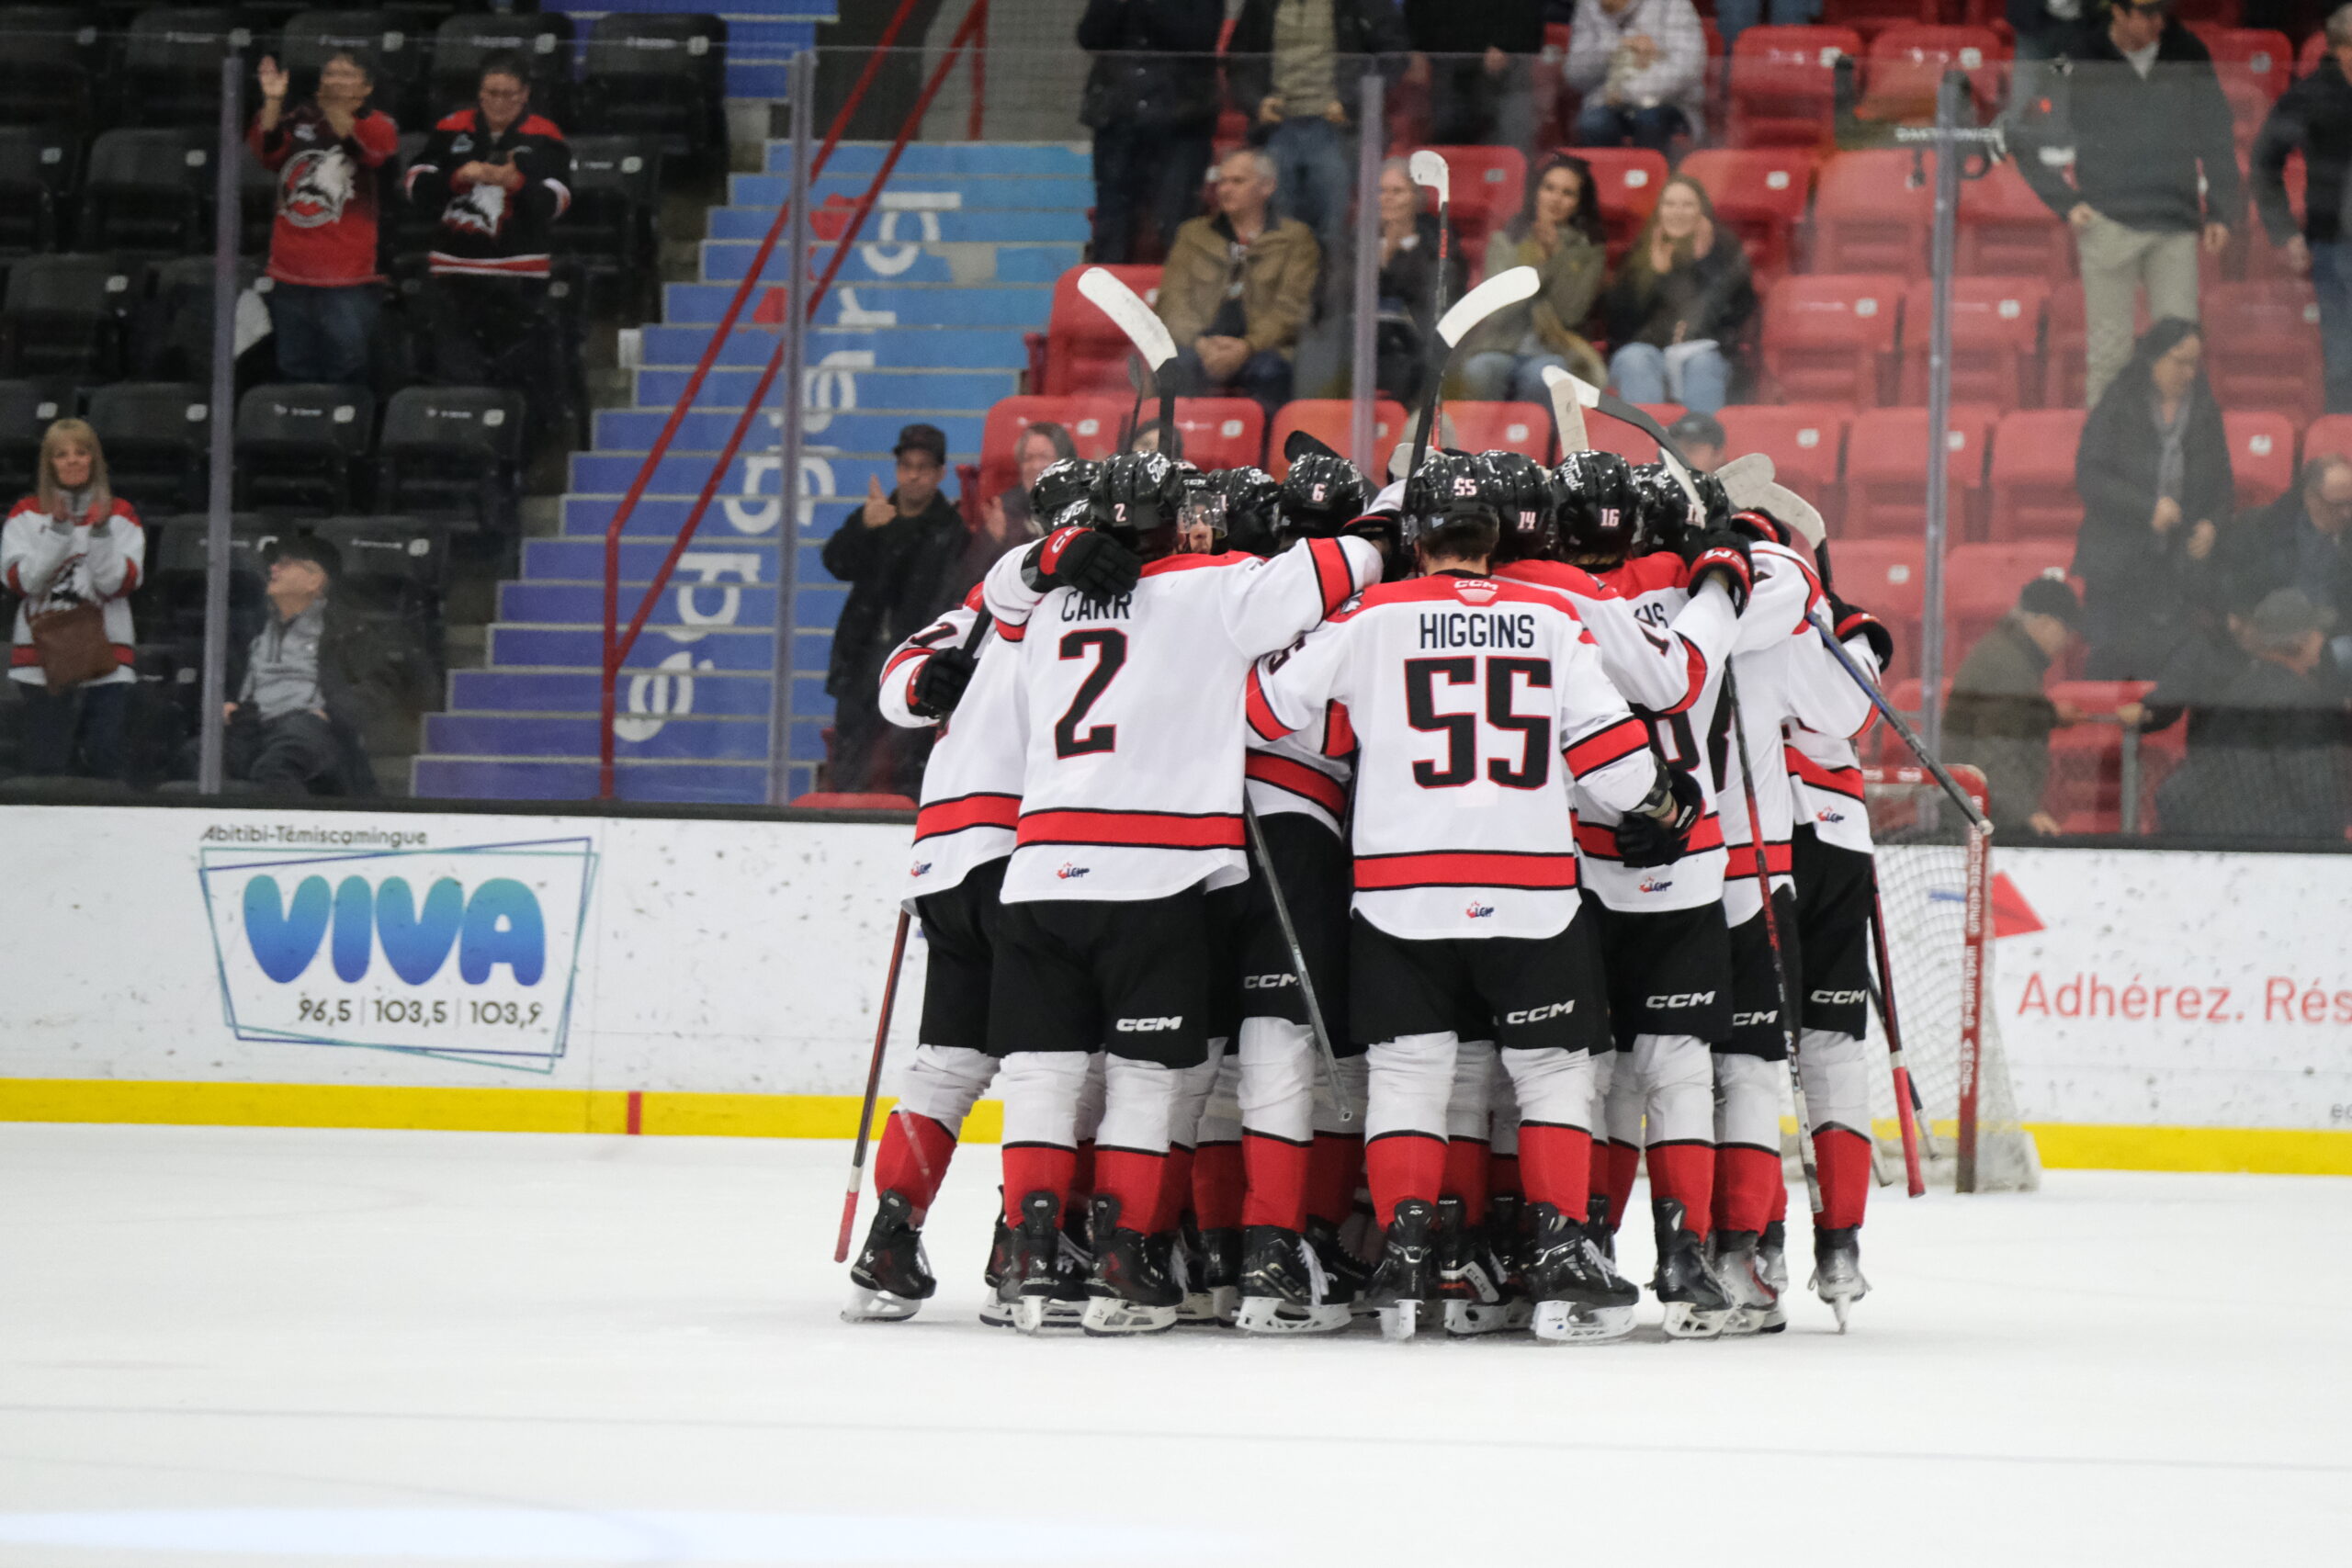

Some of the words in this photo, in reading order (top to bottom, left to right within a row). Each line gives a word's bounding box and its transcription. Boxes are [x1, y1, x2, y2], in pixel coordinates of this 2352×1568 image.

[1312, 483, 1326, 502] 6
[1453, 477, 1477, 497] 55
[1114, 502, 1126, 523] 2
[1517, 510, 1537, 531] 14
[1600, 508, 1620, 528] 16
[1453, 579, 1499, 592] CCM
[1060, 589, 1133, 623] CARR
[1419, 613, 1535, 649] HIGGINS
[1055, 627, 1128, 760] 2
[1404, 655, 1552, 790] 55
[199, 826, 428, 848] Abitibi-Témiscamingue
[243, 874, 546, 987] VIVA
[1645, 990, 1716, 1010] CCM
[1810, 989, 1867, 1004] CCM
[2018, 972, 2245, 1023] Adhérez.
[2265, 976, 2352, 1024] Rés
[298, 999, 351, 1026] 96,5
[373, 999, 447, 1027] 103,5
[470, 1000, 544, 1029] 103,9
[1507, 999, 1576, 1024] CCM
[1116, 1016, 1183, 1032] CCM
